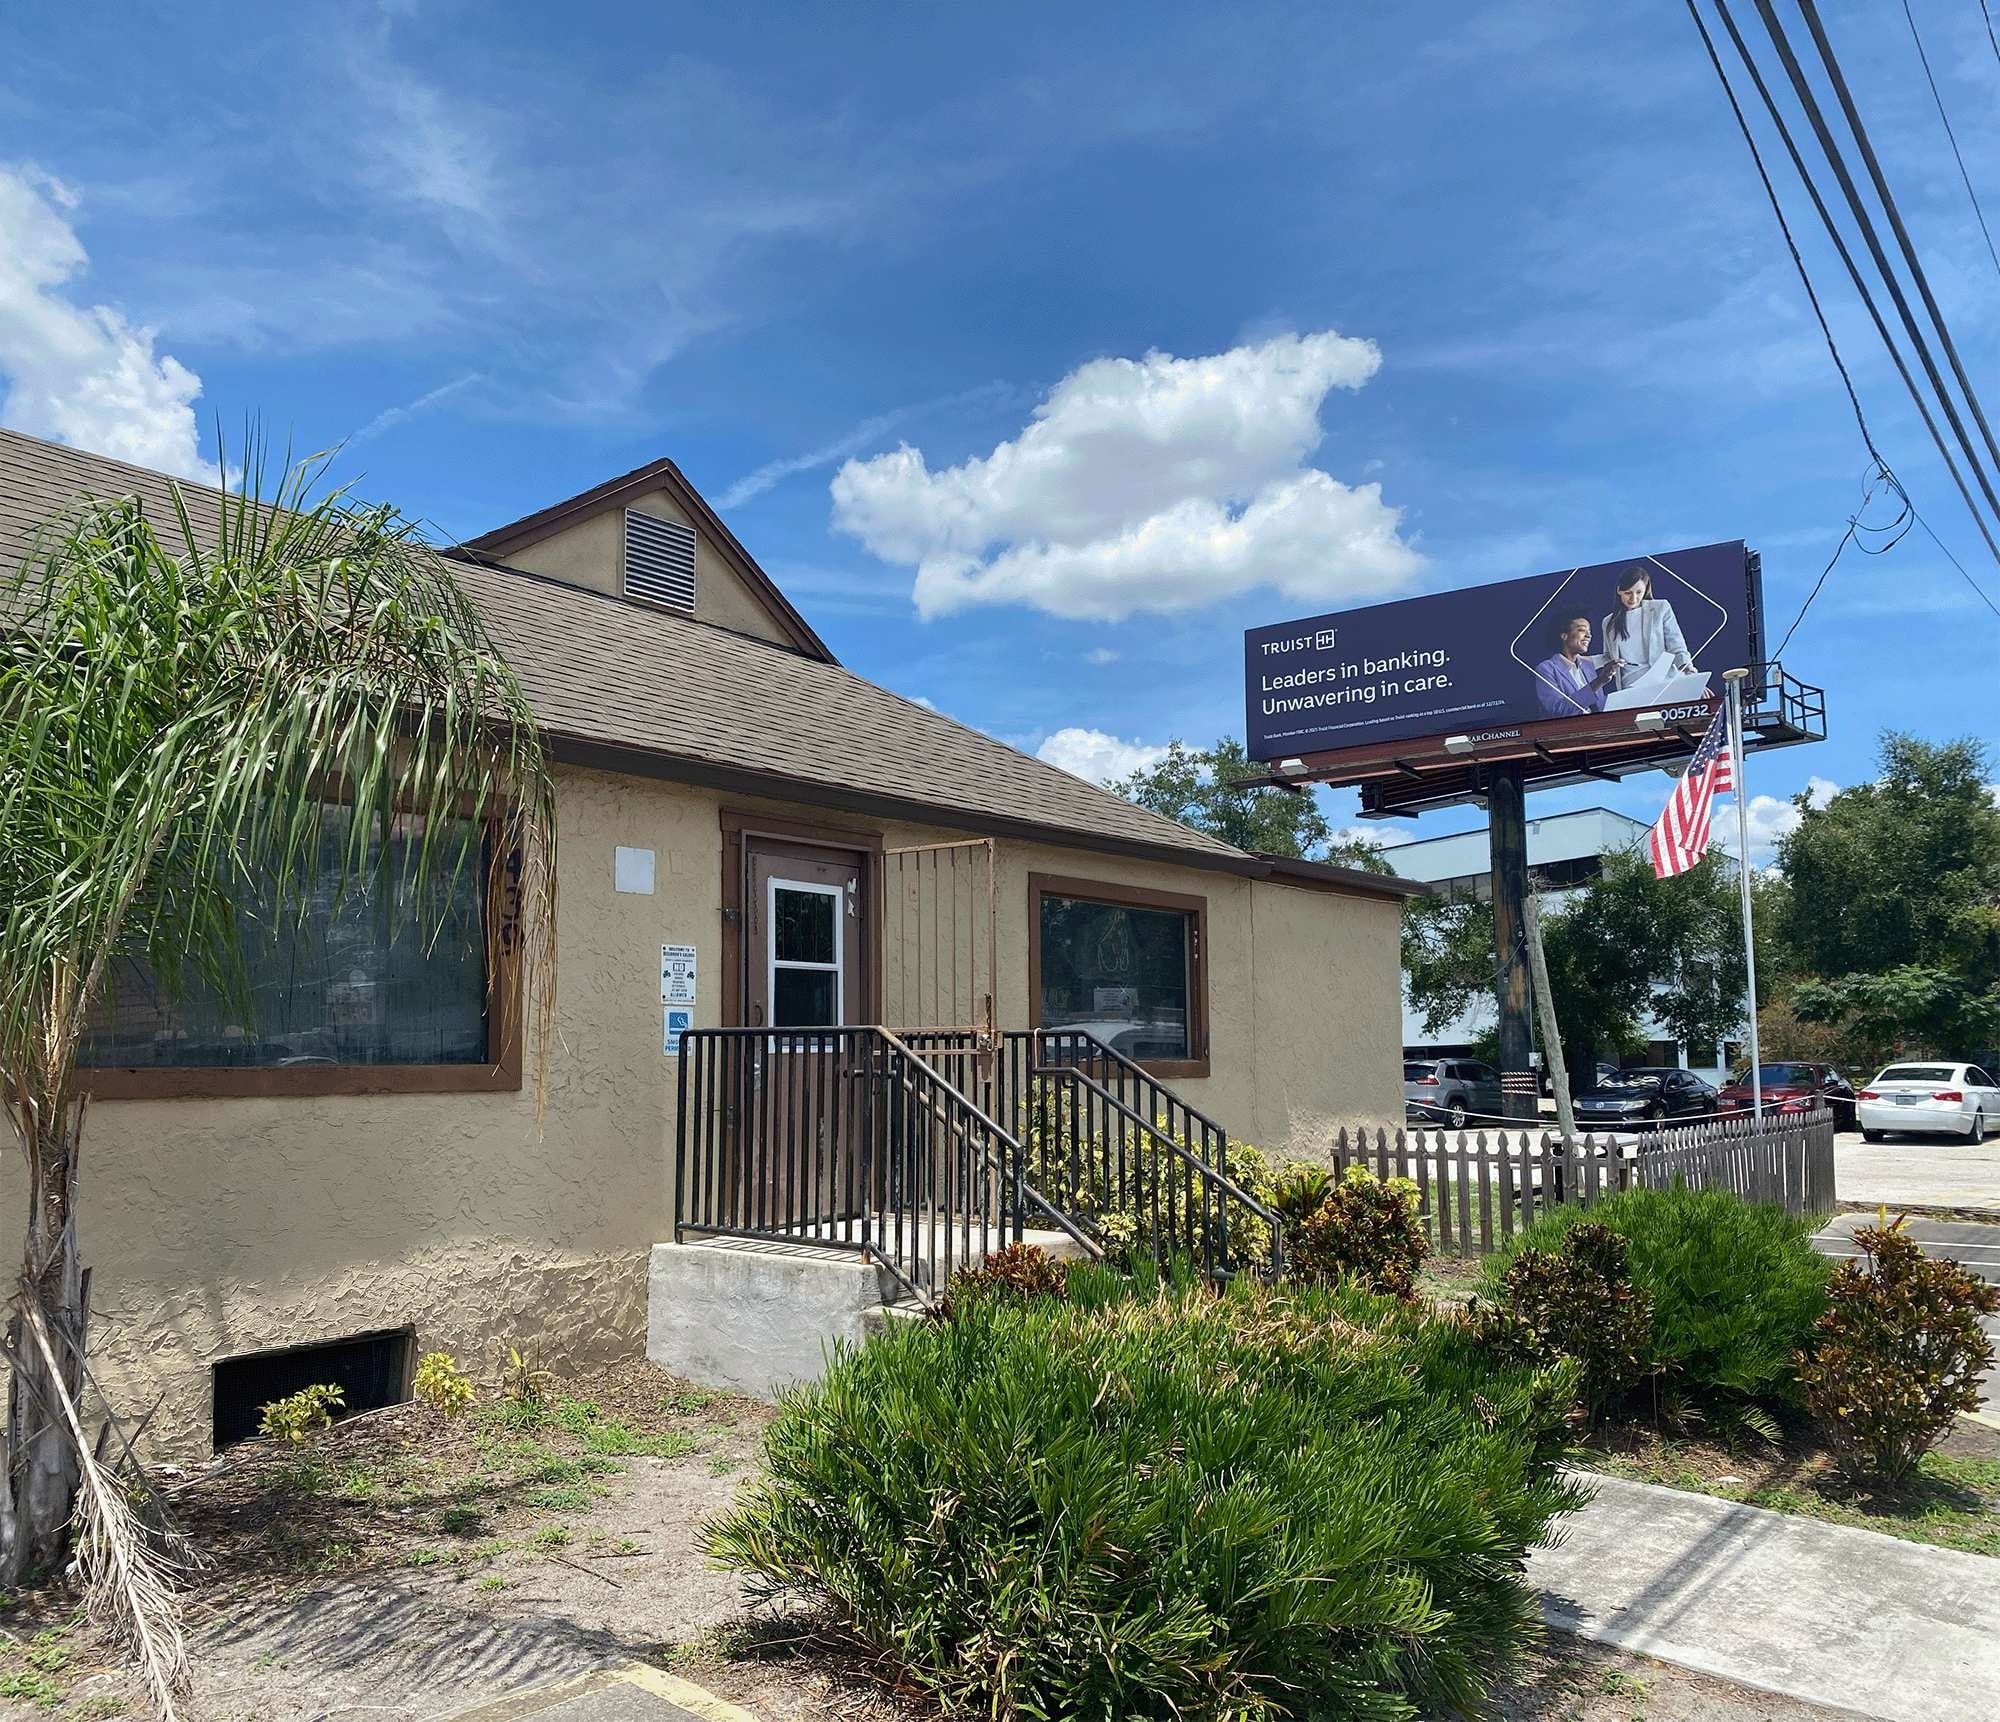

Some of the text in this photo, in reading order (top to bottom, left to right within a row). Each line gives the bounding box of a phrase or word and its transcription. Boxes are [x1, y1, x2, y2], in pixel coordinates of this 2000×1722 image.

[1261, 636, 1312, 655] TRUIST
[1262, 650, 1450, 691] Leaders in banking.
[1262, 674, 1453, 715] Unwavering in care.
[1660, 704, 1709, 721] 005732
[1468, 729, 1521, 742] ARCHANNEL
